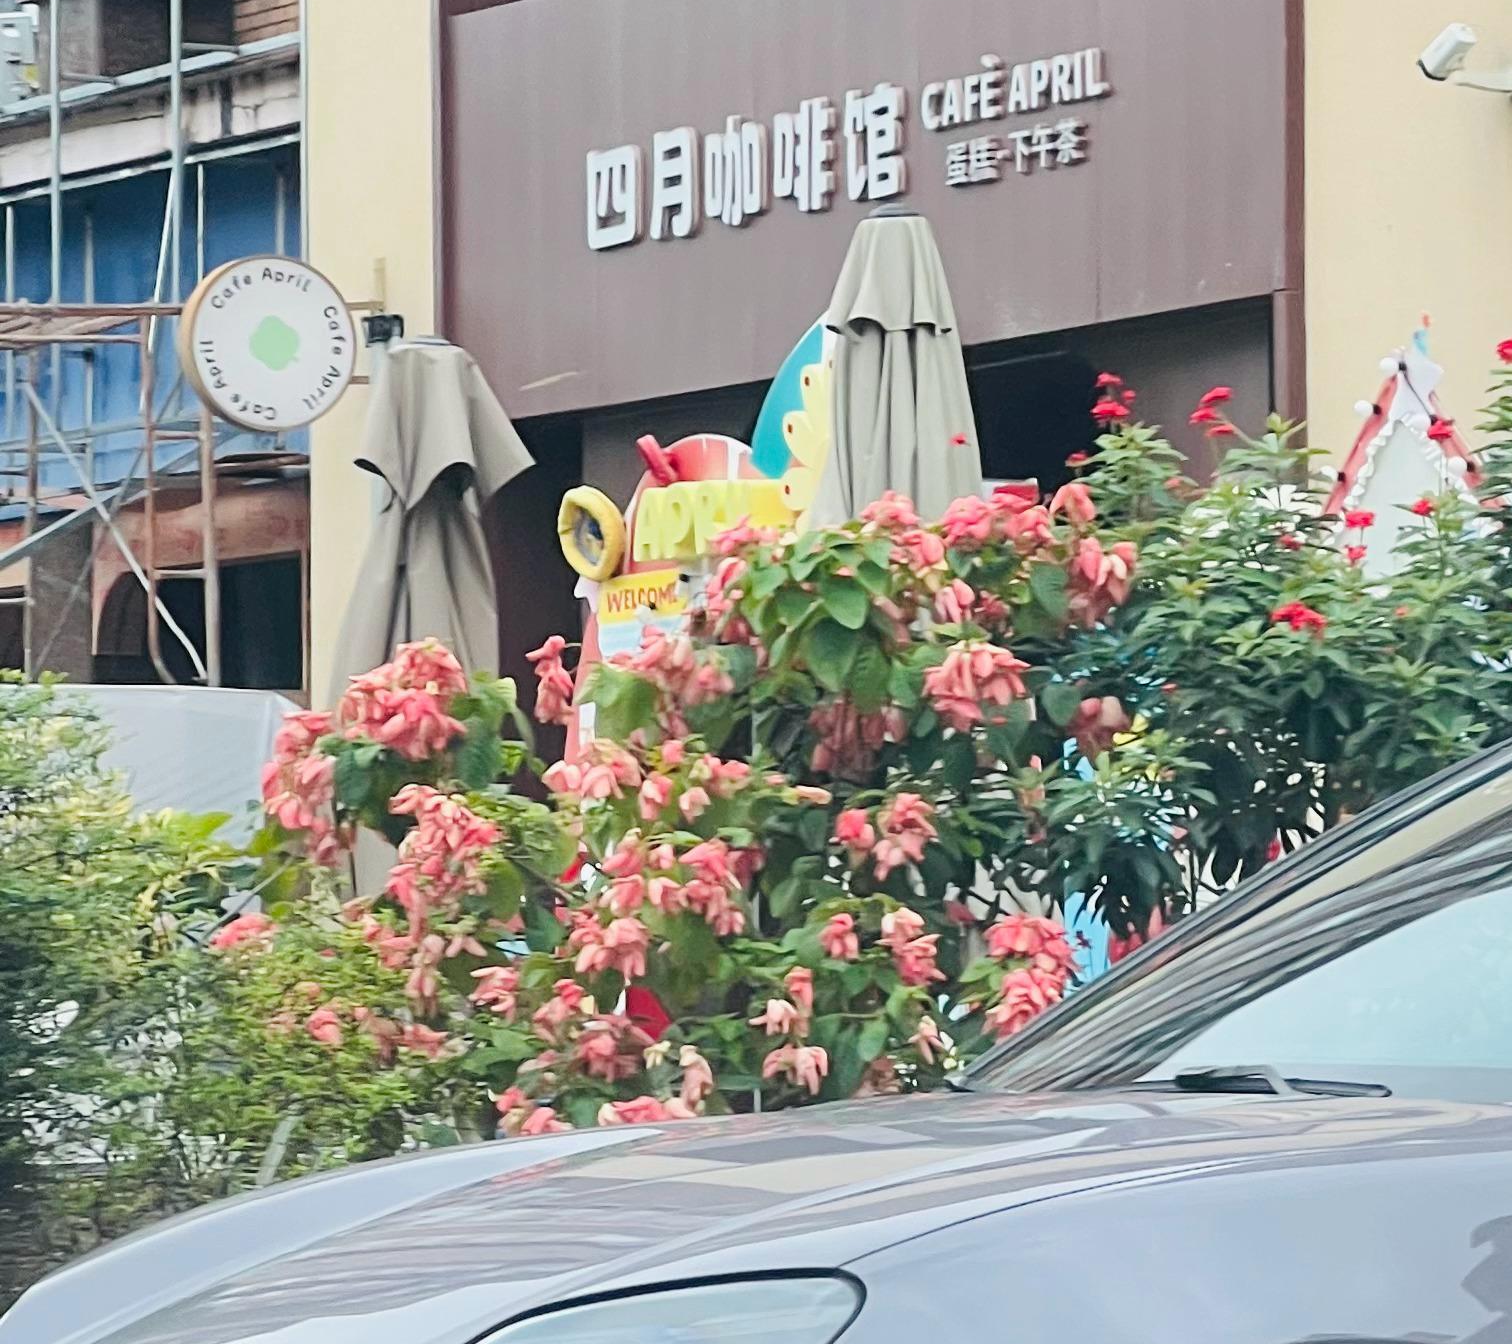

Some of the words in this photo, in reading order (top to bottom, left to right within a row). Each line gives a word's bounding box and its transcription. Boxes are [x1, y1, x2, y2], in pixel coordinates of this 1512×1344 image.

[1008, 47, 1109, 113] APRIL
[586, 82, 907, 251] 四月咖啡馆
[211, 273, 252, 309] Cafe
[262, 267, 312, 292] April
[323, 305, 347, 356] Cafe
[199, 339, 228, 390] April
[303, 365, 341, 410] April
[229, 393, 278, 421] Cafe
